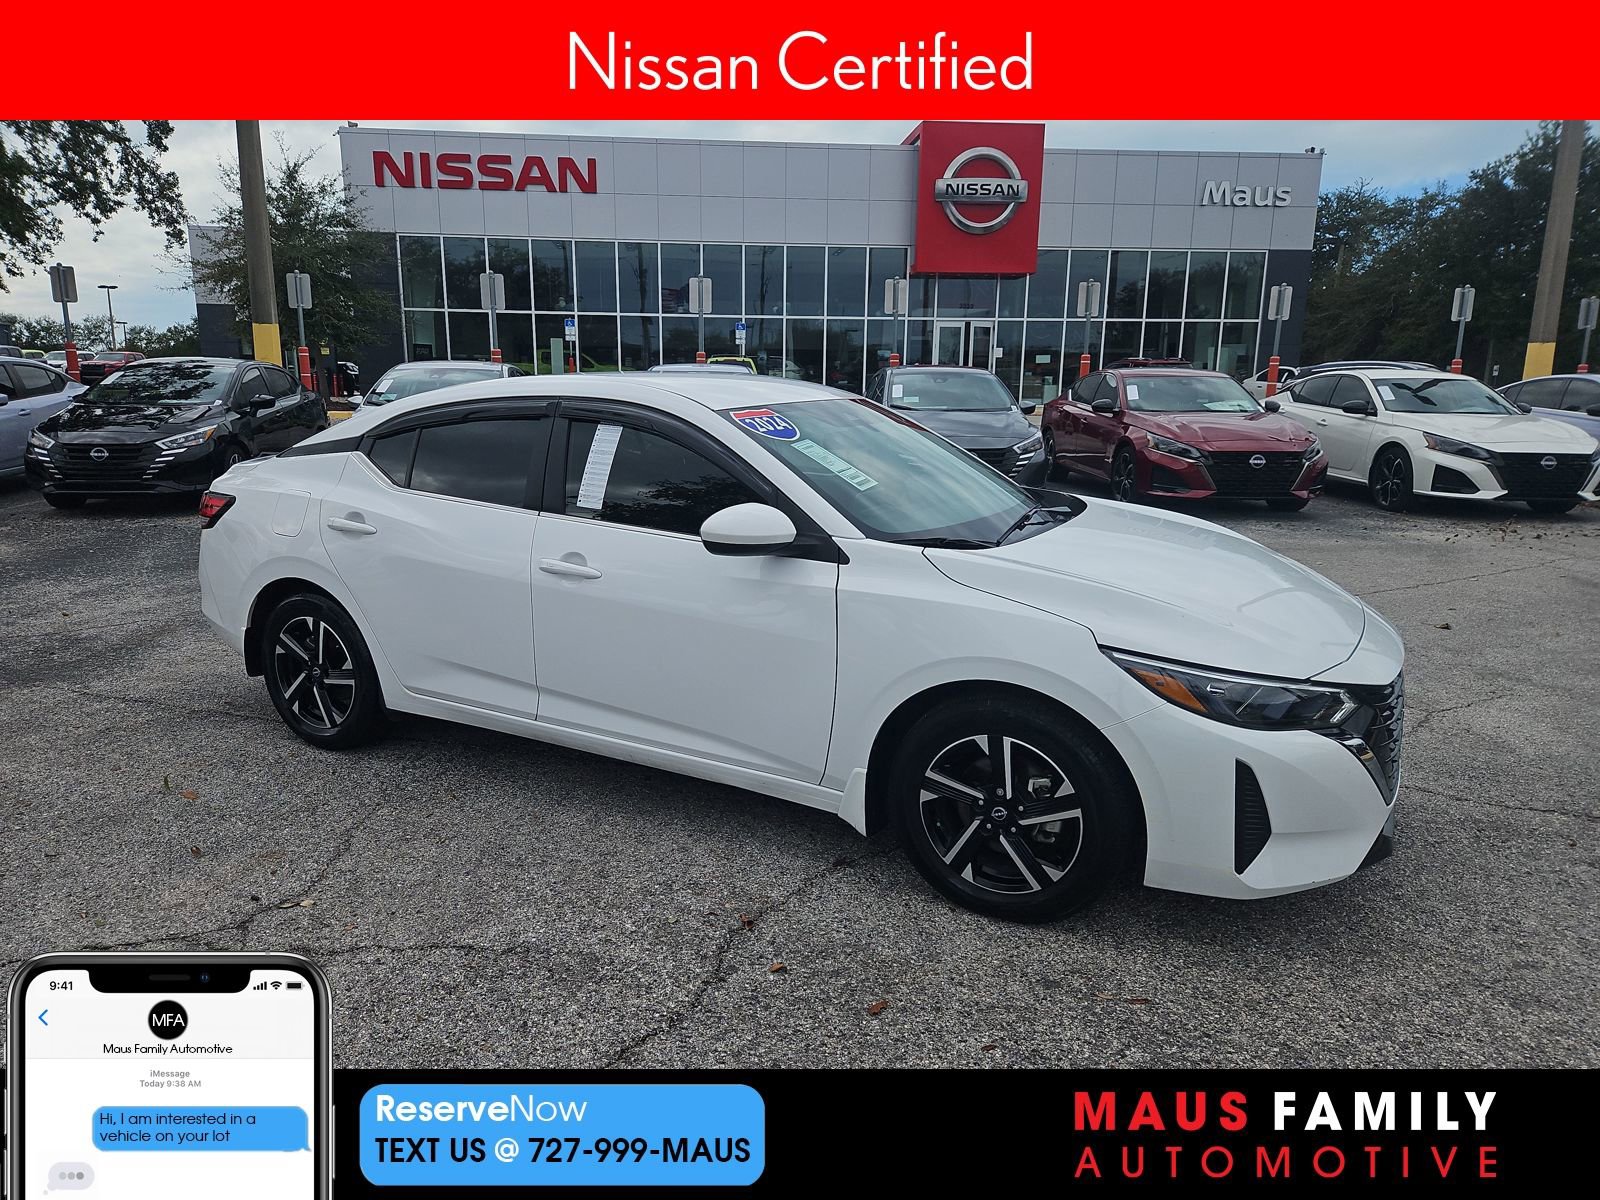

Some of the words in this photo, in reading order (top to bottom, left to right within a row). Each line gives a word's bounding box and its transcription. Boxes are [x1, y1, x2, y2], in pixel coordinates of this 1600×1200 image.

[373, 151, 597, 194] NISSAN
[945, 183, 1019, 196] NISSAN
[1202, 180, 1292, 206] Maus
[744, 416, 793, 431] 2024
